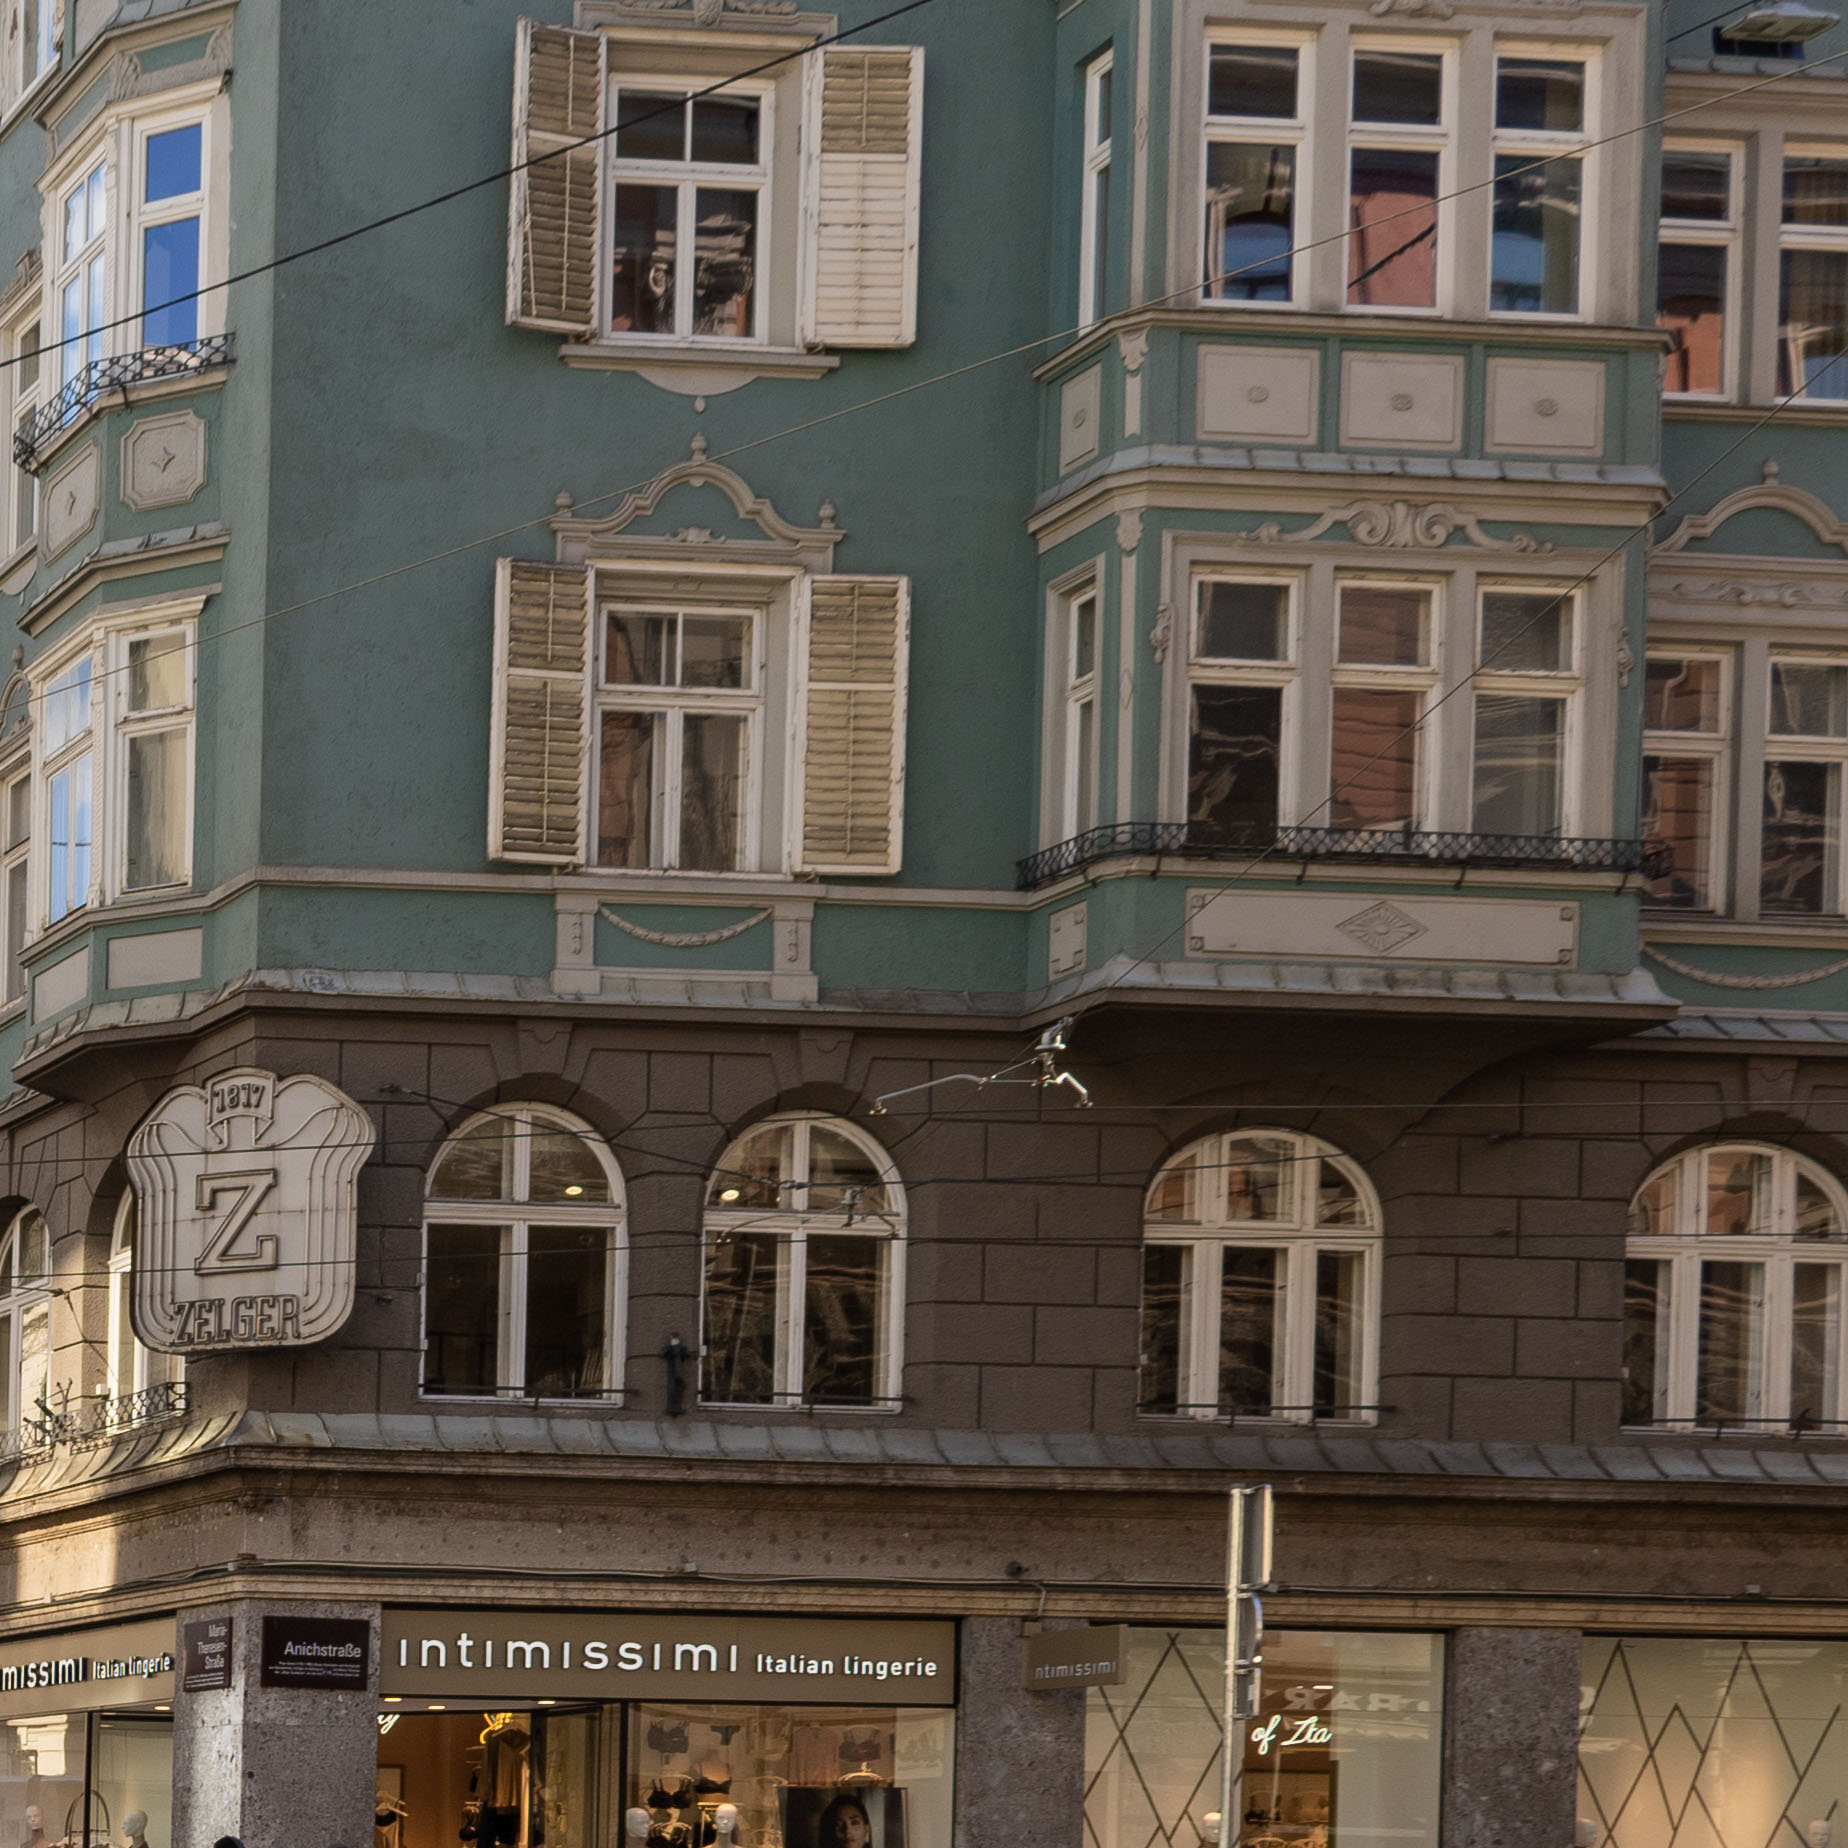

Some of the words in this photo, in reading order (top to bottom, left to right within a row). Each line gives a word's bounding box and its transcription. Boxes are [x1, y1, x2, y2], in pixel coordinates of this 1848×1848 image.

[212, 1082, 267, 1113] 1817
[194, 1168, 278, 1276] Z
[172, 1294, 301, 1347] ZELGER
[92, 1659, 126, 1681] Italian
[128, 1652, 171, 1679] lingerie
[284, 1640, 362, 1659] Anichstraße
[398, 1633, 740, 1672] intimissimi
[755, 1653, 835, 1675] Italian
[843, 1653, 939, 1680] lingerie
[1250, 1714, 1282, 1755] of
